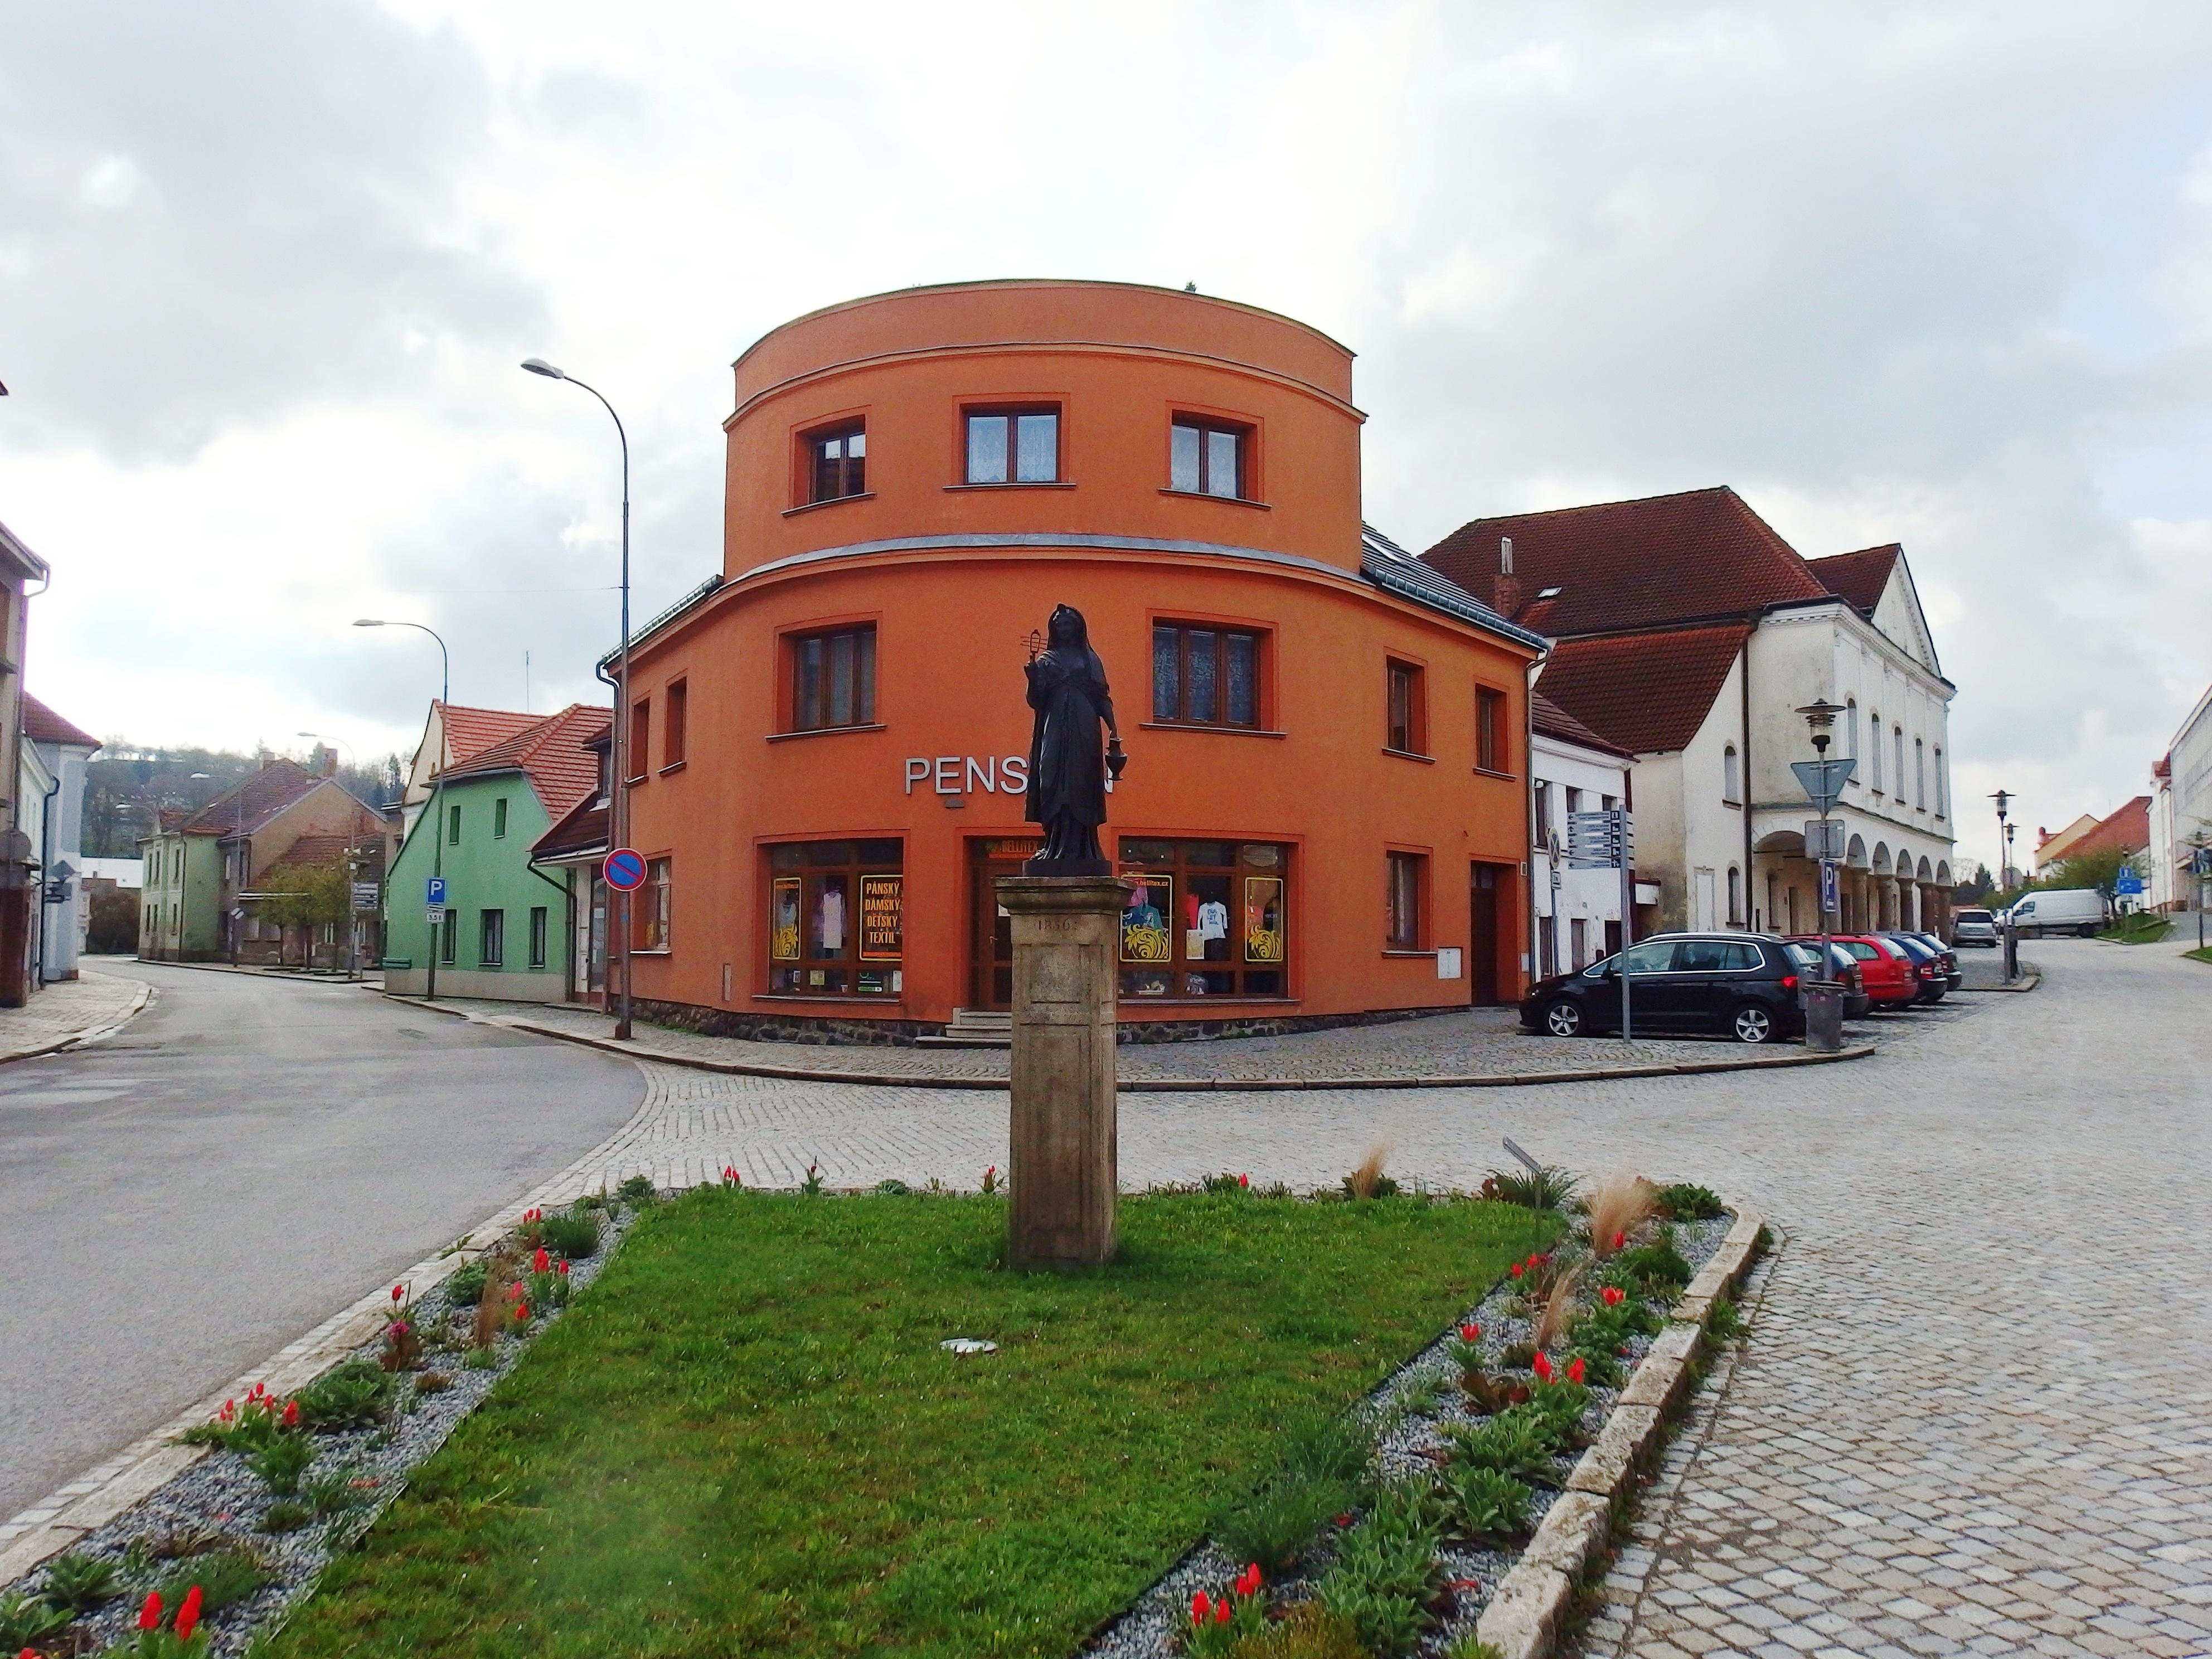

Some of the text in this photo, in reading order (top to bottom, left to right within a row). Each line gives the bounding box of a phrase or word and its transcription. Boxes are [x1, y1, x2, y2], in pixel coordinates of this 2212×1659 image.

[905, 756, 1113, 794] PENS
[430, 880, 443, 896] P
[866, 881, 900, 895] PÁNSKÝ
[1826, 866, 1833, 895] P
[870, 932, 896, 944] TEXTIL
